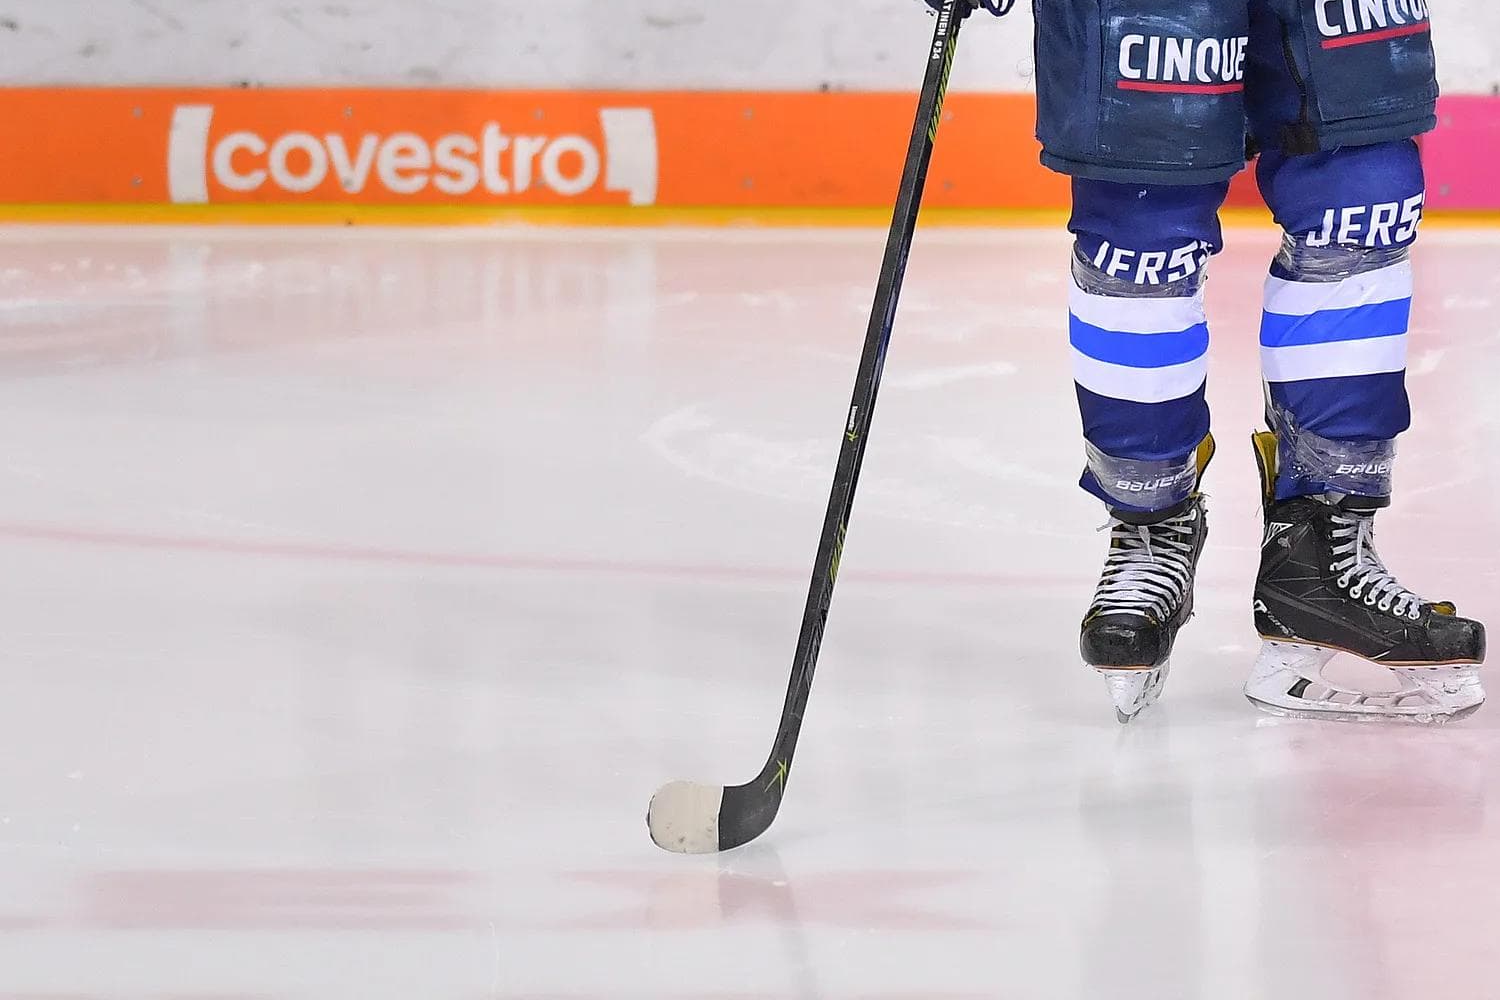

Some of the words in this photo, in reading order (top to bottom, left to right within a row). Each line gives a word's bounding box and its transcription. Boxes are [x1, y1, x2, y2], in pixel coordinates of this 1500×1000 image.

[1118, 34, 1249, 83] CINQUE
[212, 121, 600, 195] covestro
[1115, 471, 1185, 492] BAUER
